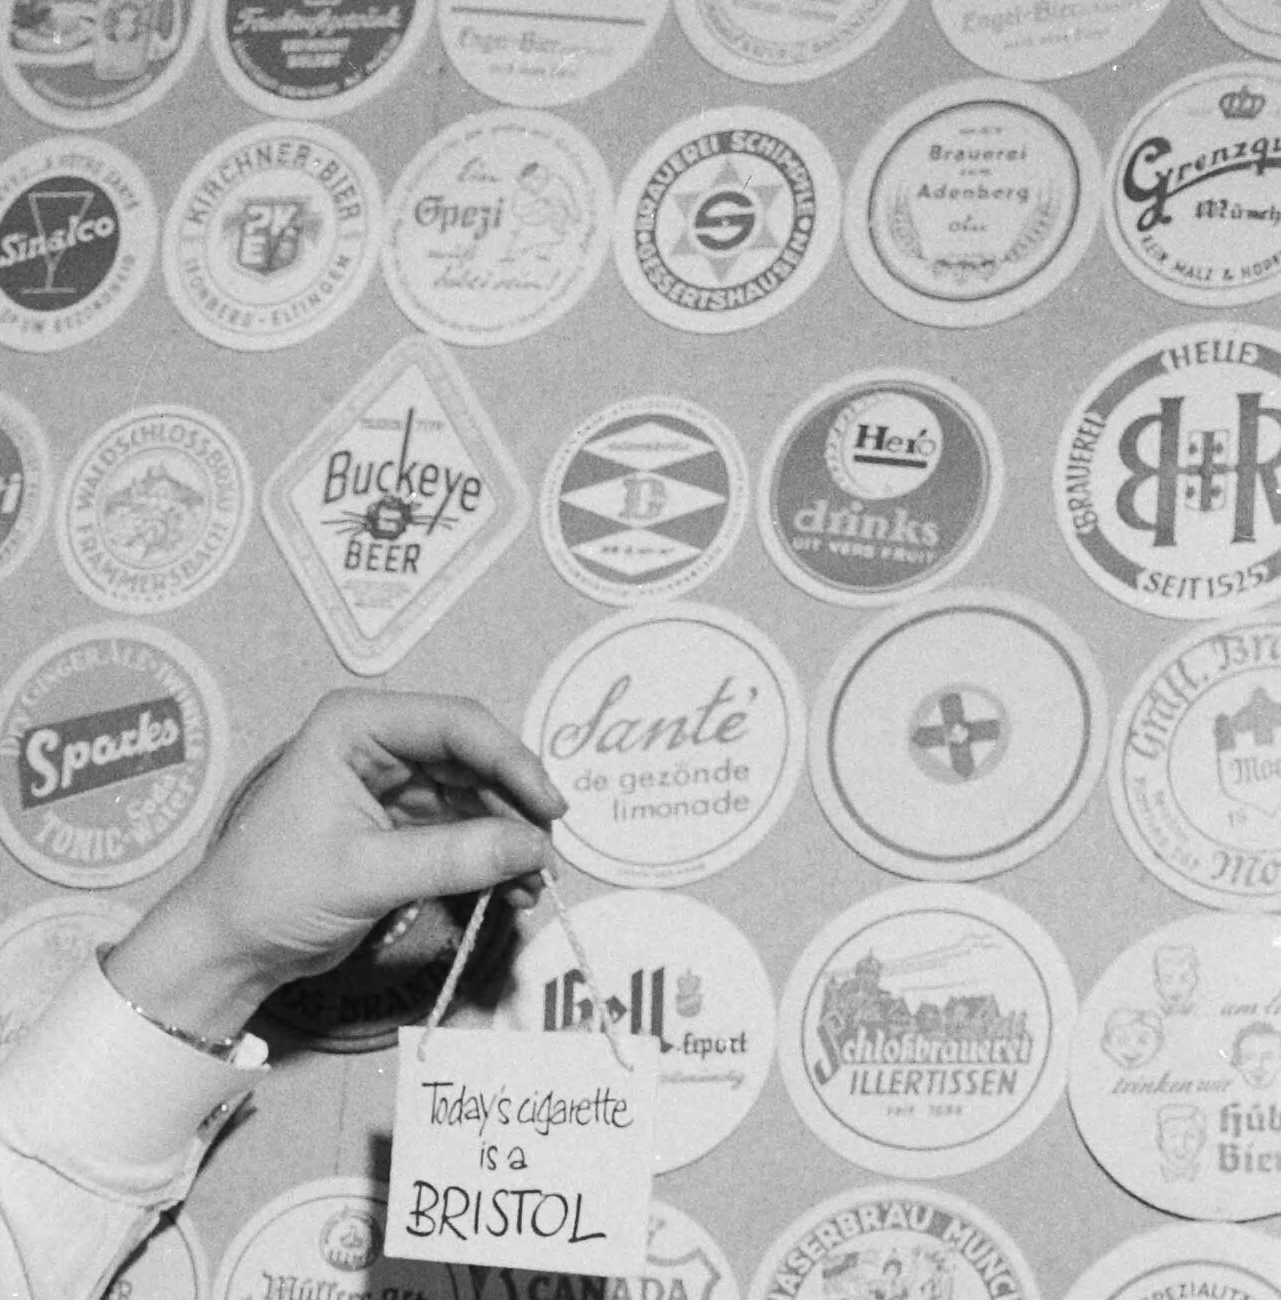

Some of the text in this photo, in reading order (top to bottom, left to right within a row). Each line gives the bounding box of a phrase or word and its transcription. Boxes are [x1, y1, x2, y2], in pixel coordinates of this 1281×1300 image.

[928, 145, 1028, 162] Brauerei
[634, 131, 721, 231] BRAUEREI
[917, 183, 1029, 202] Adenberg
[694, 190, 756, 251] S
[323, 449, 482, 537] Buckeye
[1065, 410, 1108, 535] BRAUEREI
[794, 499, 939, 547] drinks
[343, 541, 422, 574] BEER
[1144, 562, 1266, 600] SEIT 1525
[25, 710, 179, 798] Sparks
[574, 768, 609, 794] de
[613, 789, 751, 824] limonade
[849, 1069, 1018, 1096] ILLERTISSEN
[421, 1081, 634, 1137] Today's cigarette
[480, 1142, 528, 1171] is a
[405, 1180, 607, 1243] BRISTOL
